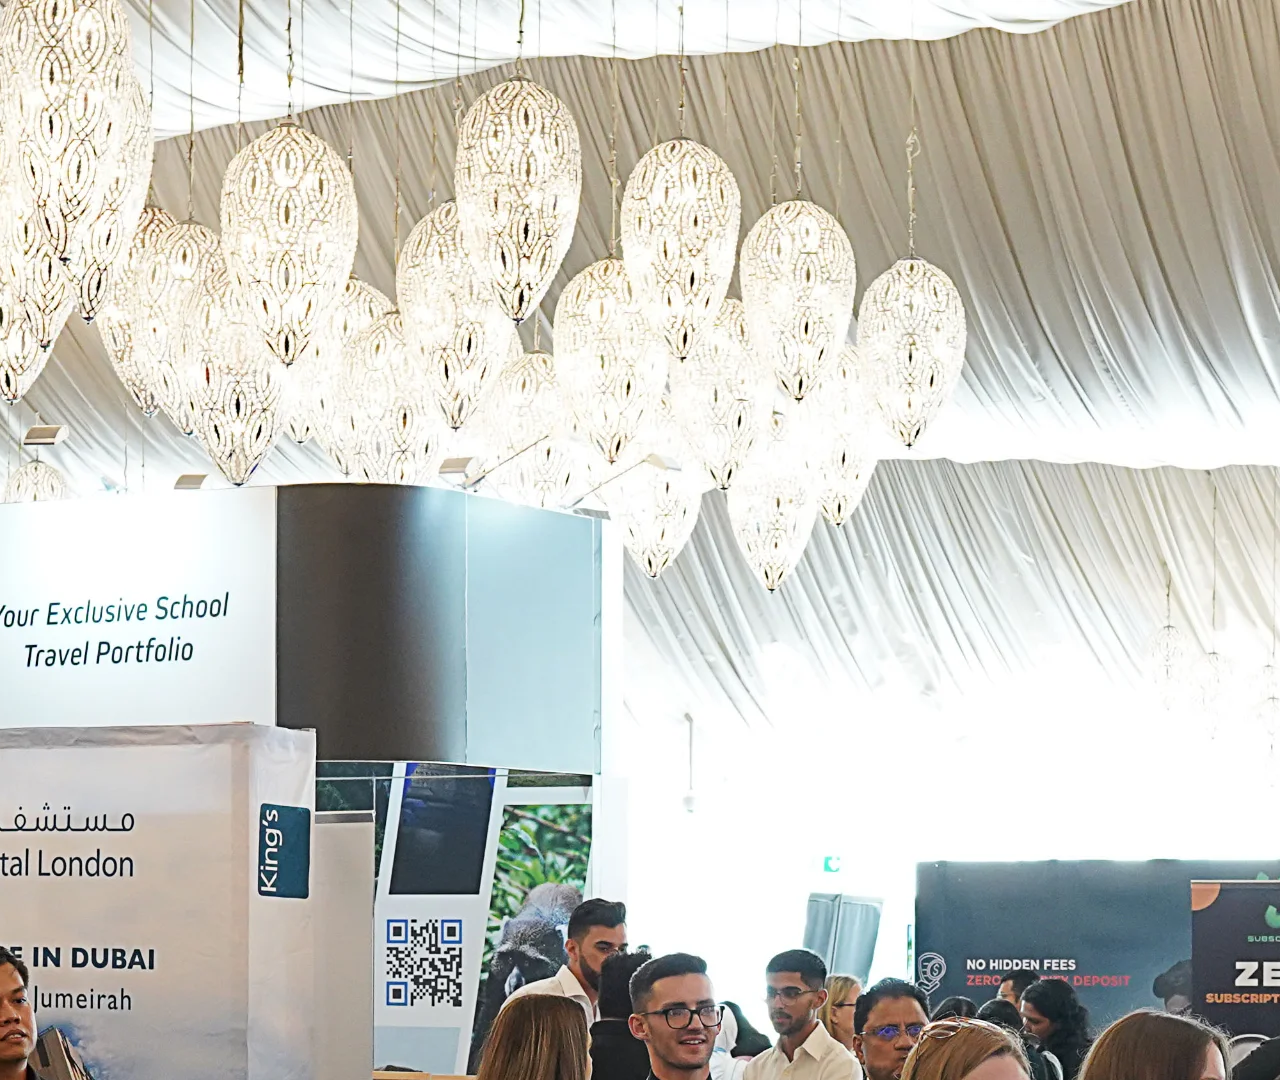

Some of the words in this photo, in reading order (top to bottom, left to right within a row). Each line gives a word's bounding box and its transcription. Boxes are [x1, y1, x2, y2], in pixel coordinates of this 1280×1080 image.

[46, 598, 148, 625] Exclusive
[155, 592, 229, 620] School
[25, 641, 89, 667] Travel
[96, 636, 194, 664] Portfolio
[38, 848, 134, 878] London
[260, 809, 283, 893] King's
[33, 947, 61, 967] IN
[71, 948, 155, 970] DUBAI
[966, 959, 986, 970] NO
[989, 959, 1040, 971] HIDDEN
[1043, 959, 1076, 971] FEES
[966, 975, 1001, 986] ZERO
[1073, 975, 1131, 987] DEPOSIT
[33, 985, 132, 1012] Jumeirah
